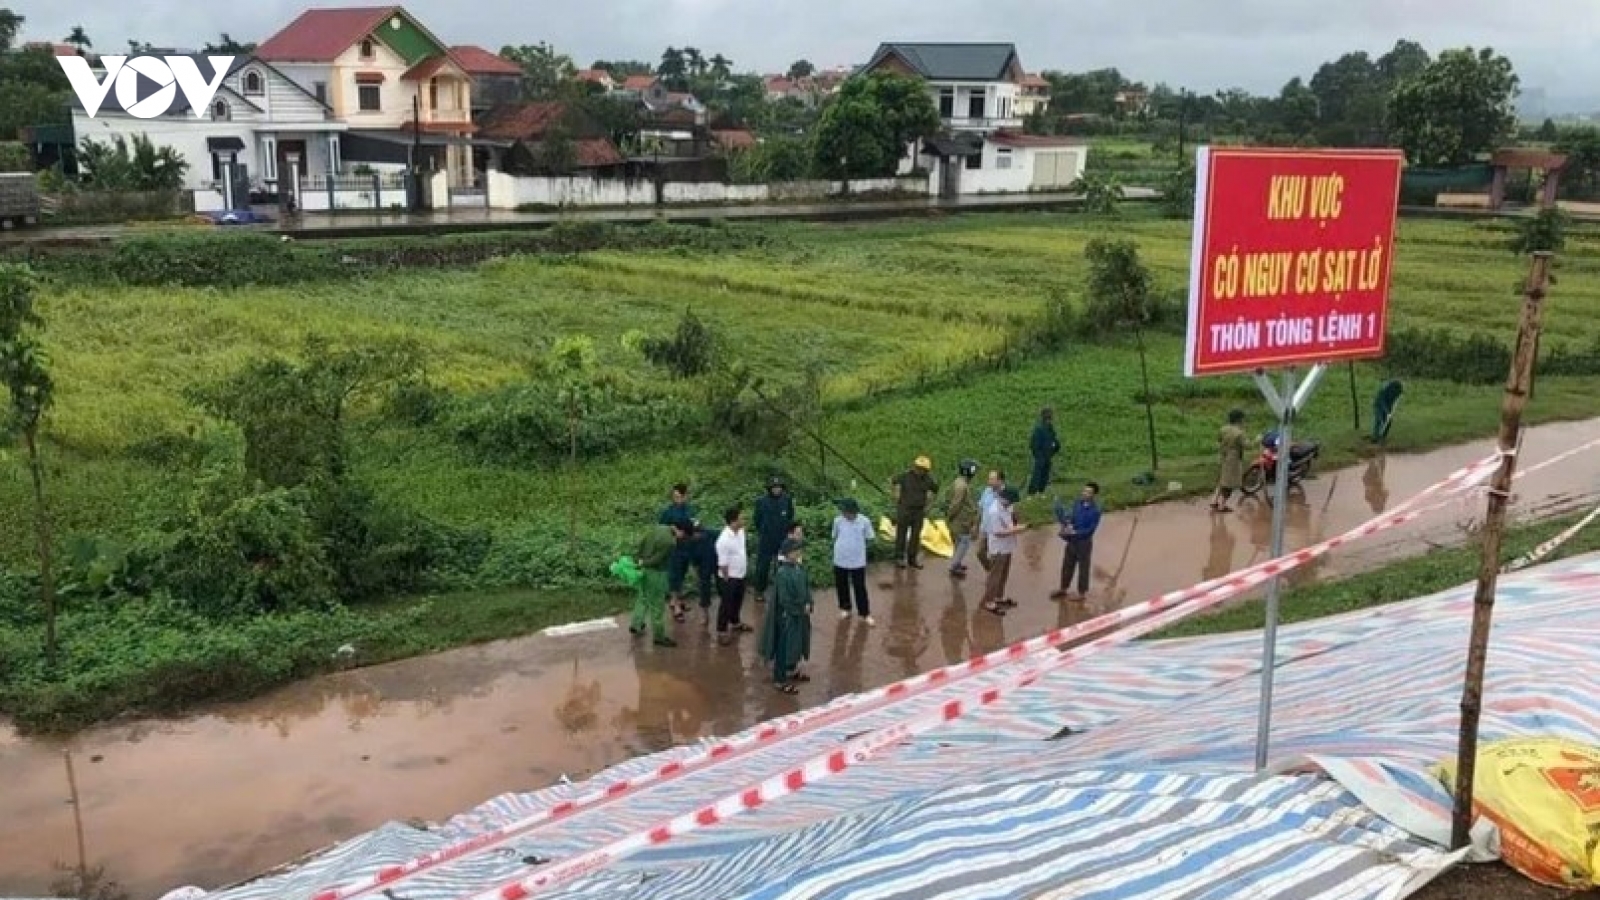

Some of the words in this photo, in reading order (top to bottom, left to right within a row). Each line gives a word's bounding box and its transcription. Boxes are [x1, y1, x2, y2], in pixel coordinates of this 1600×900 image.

[1268, 175, 1306, 219] KHU
[1310, 171, 1344, 228] VỰC
[1213, 245, 1239, 299] CÓ
[1242, 252, 1293, 297] NGUY
[1295, 247, 1322, 293] CƠ
[1322, 250, 1357, 301] SẠT
[1358, 235, 1384, 290] LỞ
[1210, 315, 1260, 353] THÔN
[1266, 312, 1313, 347] TÒNG
[1317, 309, 1362, 347] LỆNH
[1367, 313, 1376, 338] 1
